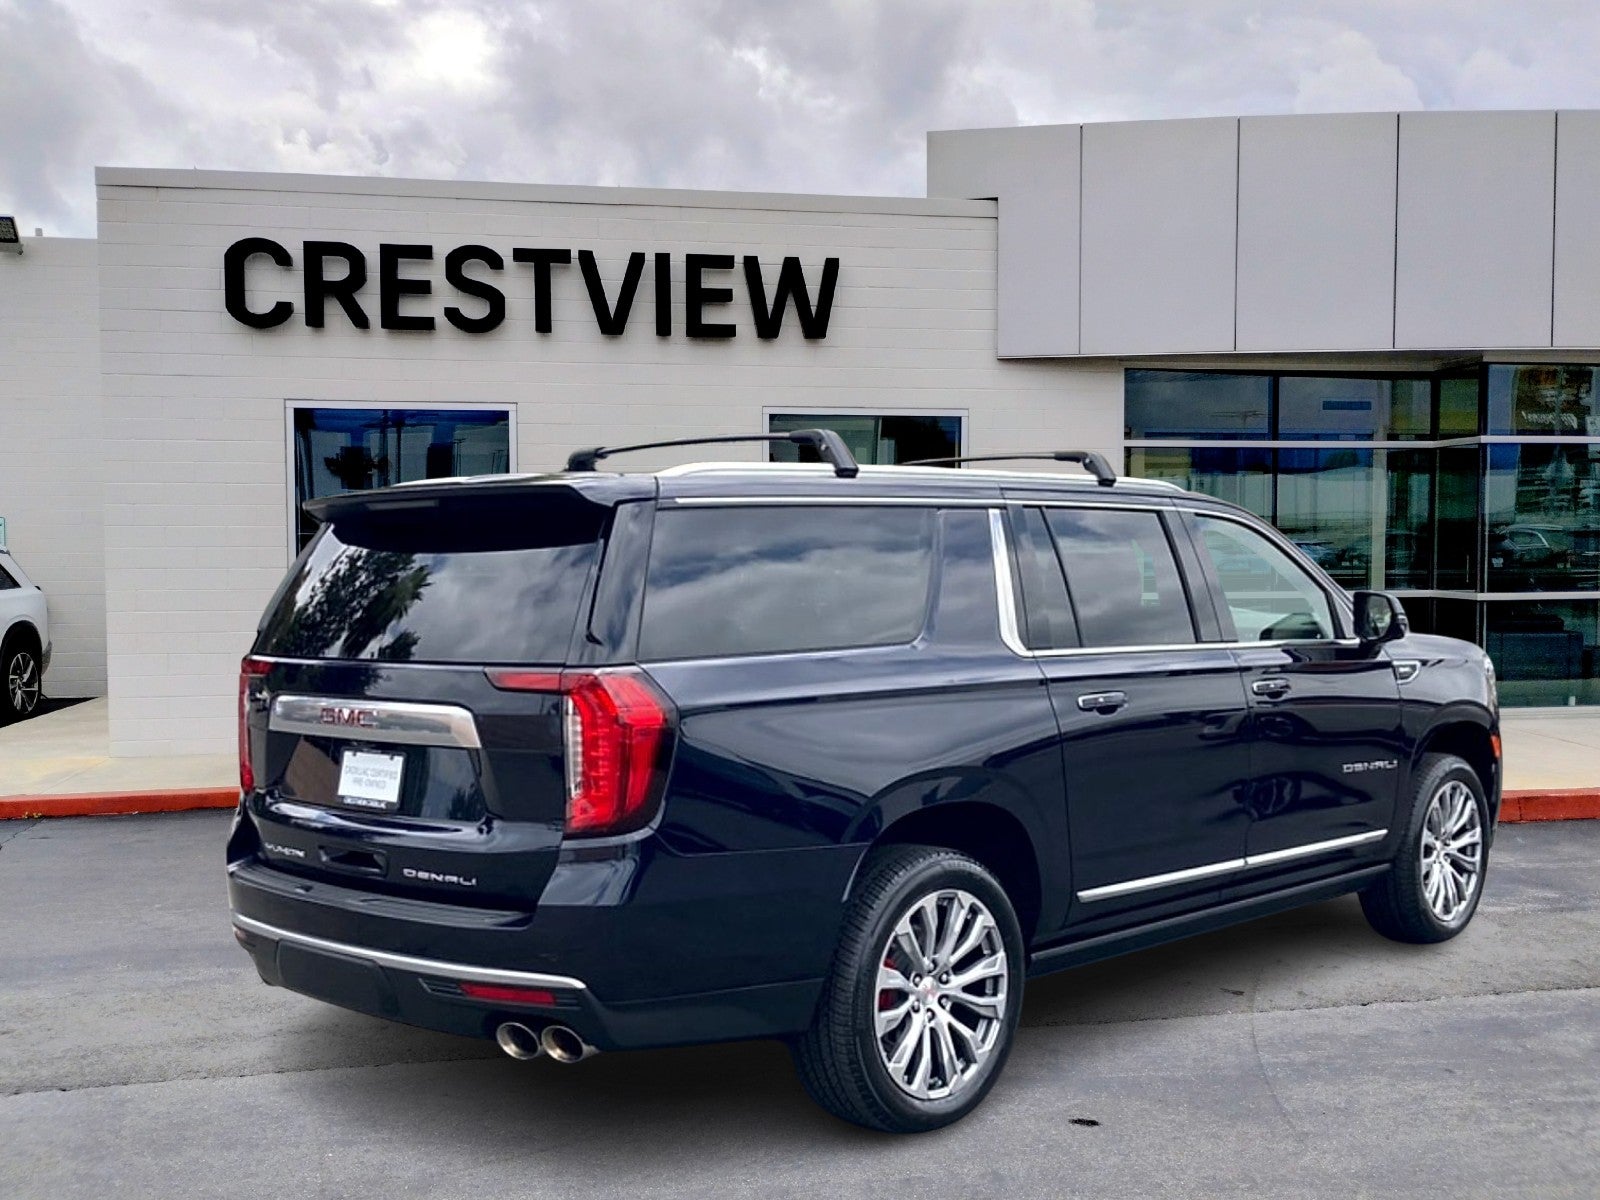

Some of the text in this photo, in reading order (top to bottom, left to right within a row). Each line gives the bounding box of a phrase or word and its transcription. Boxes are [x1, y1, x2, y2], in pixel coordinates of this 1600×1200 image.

[224, 237, 840, 341] CRESTVIEW
[320, 707, 379, 727] GMC
[1342, 759, 1398, 773] DENALI
[402, 868, 477, 886] DENALI
